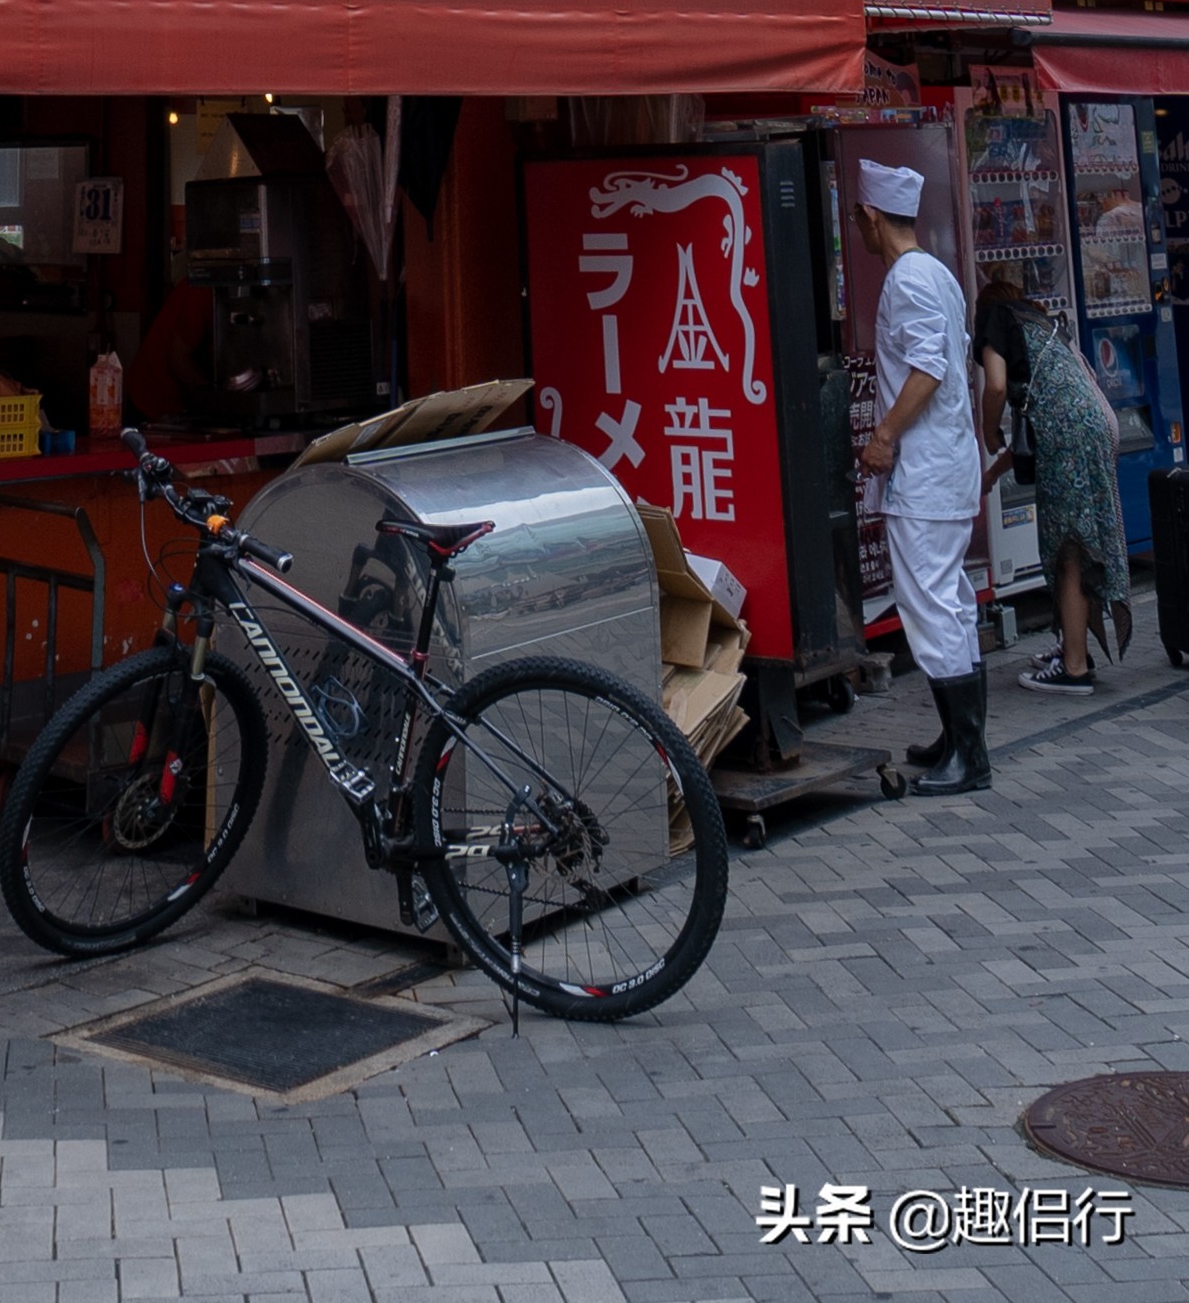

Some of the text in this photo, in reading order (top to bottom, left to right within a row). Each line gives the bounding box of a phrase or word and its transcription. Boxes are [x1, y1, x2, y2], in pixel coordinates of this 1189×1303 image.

[85, 188, 112, 221] 31
[578, 233, 648, 505] ラーメ
